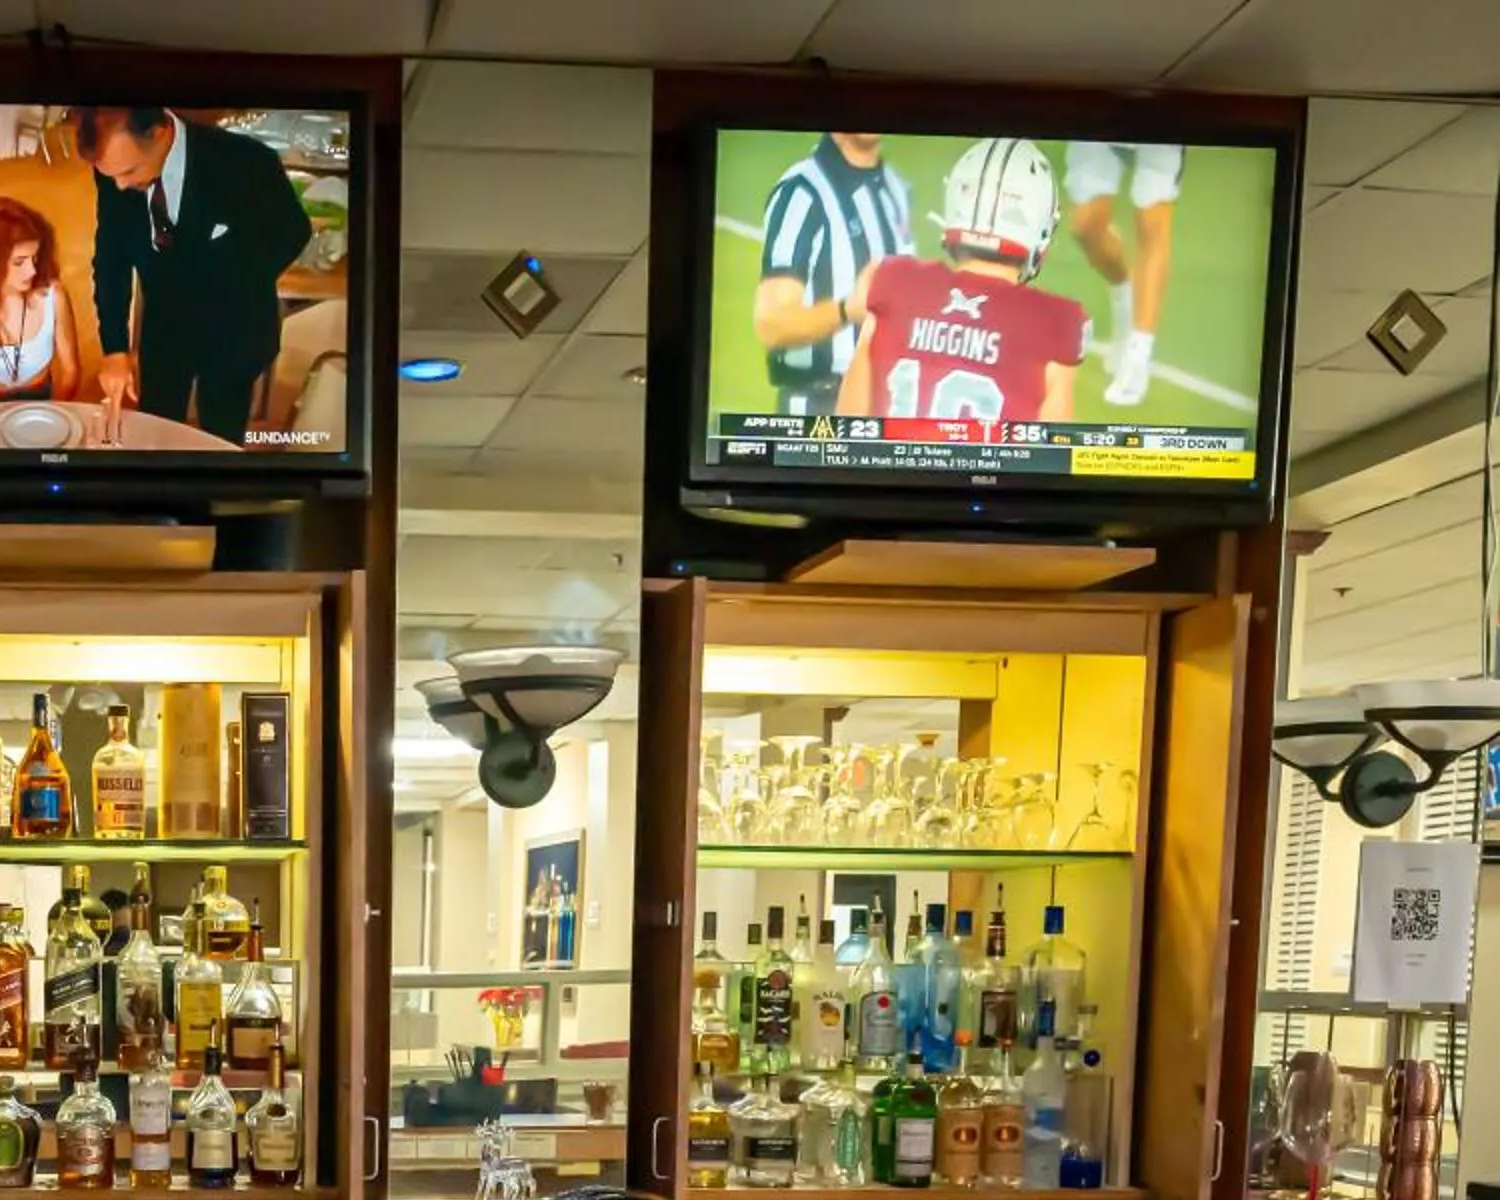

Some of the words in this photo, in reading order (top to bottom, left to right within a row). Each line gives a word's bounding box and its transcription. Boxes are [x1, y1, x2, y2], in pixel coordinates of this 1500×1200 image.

[909, 317, 1002, 365] HIGGINS
[743, 417, 768, 427] APP
[770, 418, 804, 428] STATE
[850, 419, 879, 438] 23
[938, 423, 969, 433] TROY
[1012, 425, 1041, 442] 35
[1162, 437, 1186, 449] 3RD
[1187, 438, 1227, 450] DOWN
